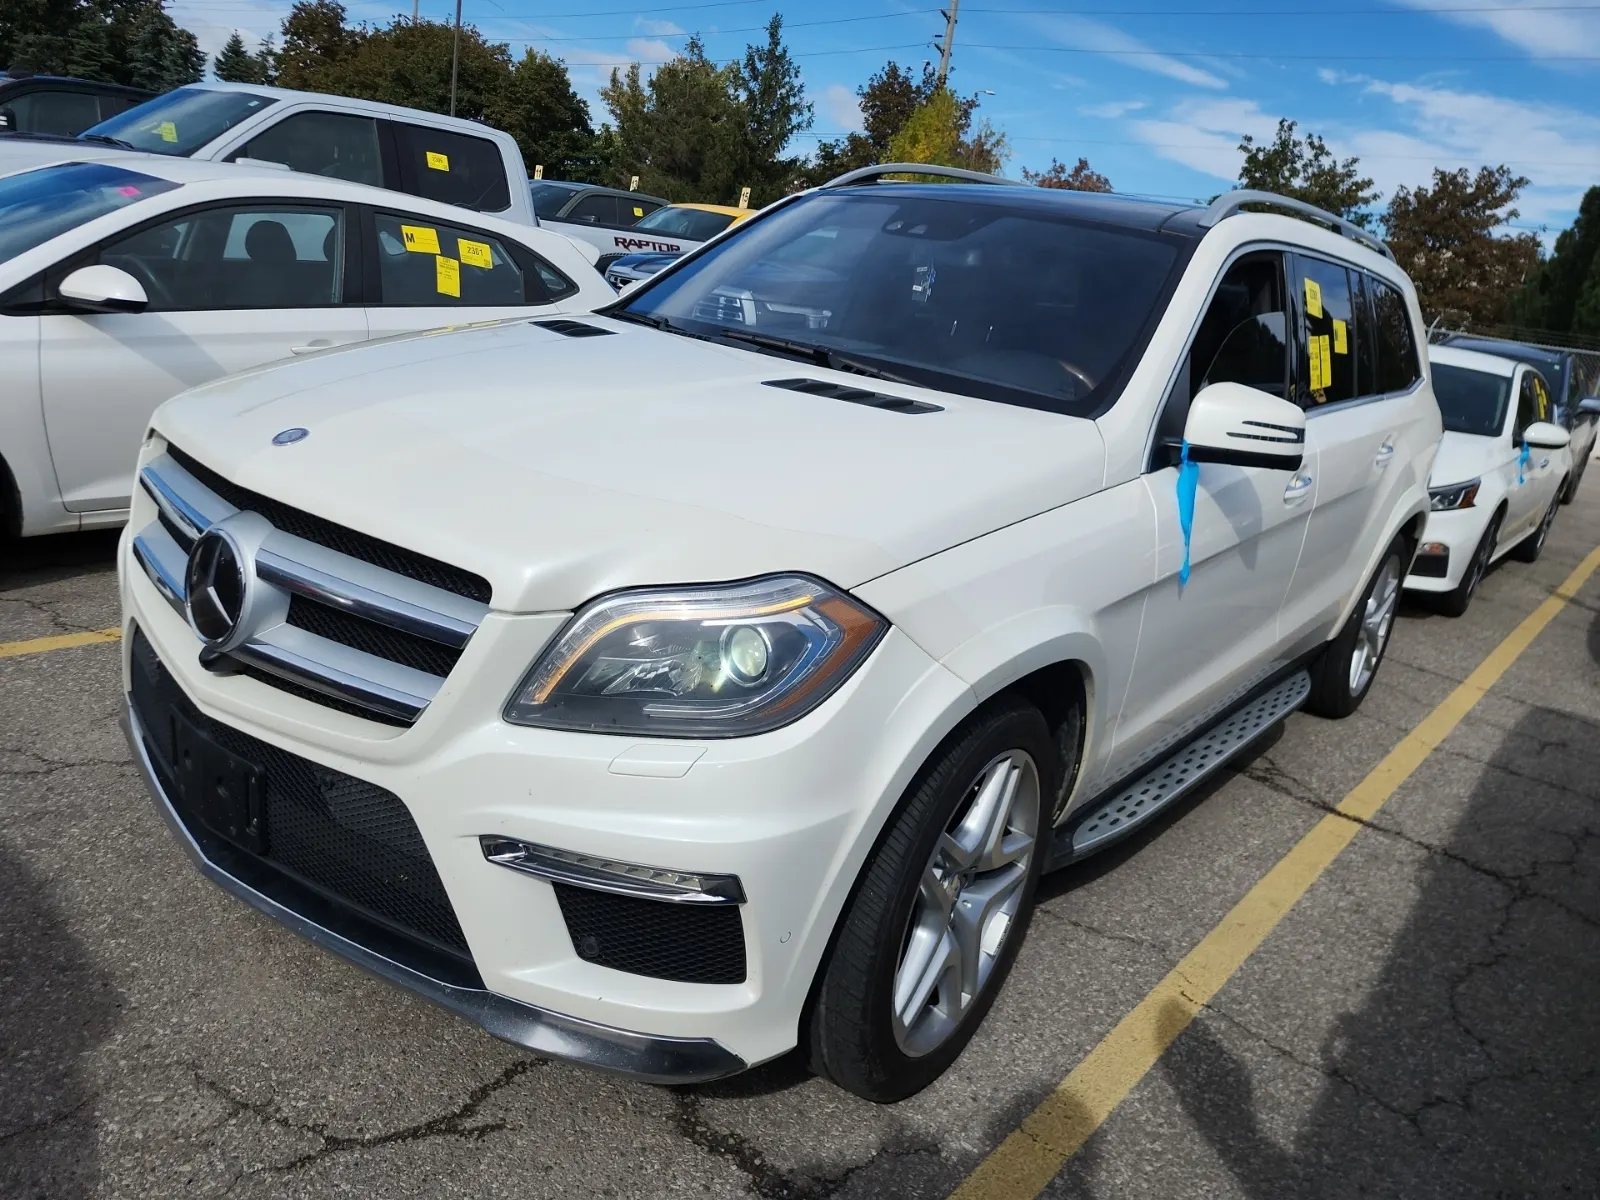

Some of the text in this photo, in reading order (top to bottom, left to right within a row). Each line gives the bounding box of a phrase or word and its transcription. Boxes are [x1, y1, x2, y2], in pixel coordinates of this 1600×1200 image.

[742, 191, 749, 203] 15
[405, 233, 416, 244] M
[614, 237, 681, 252] RAPTOR
[466, 246, 484, 257] 2301
